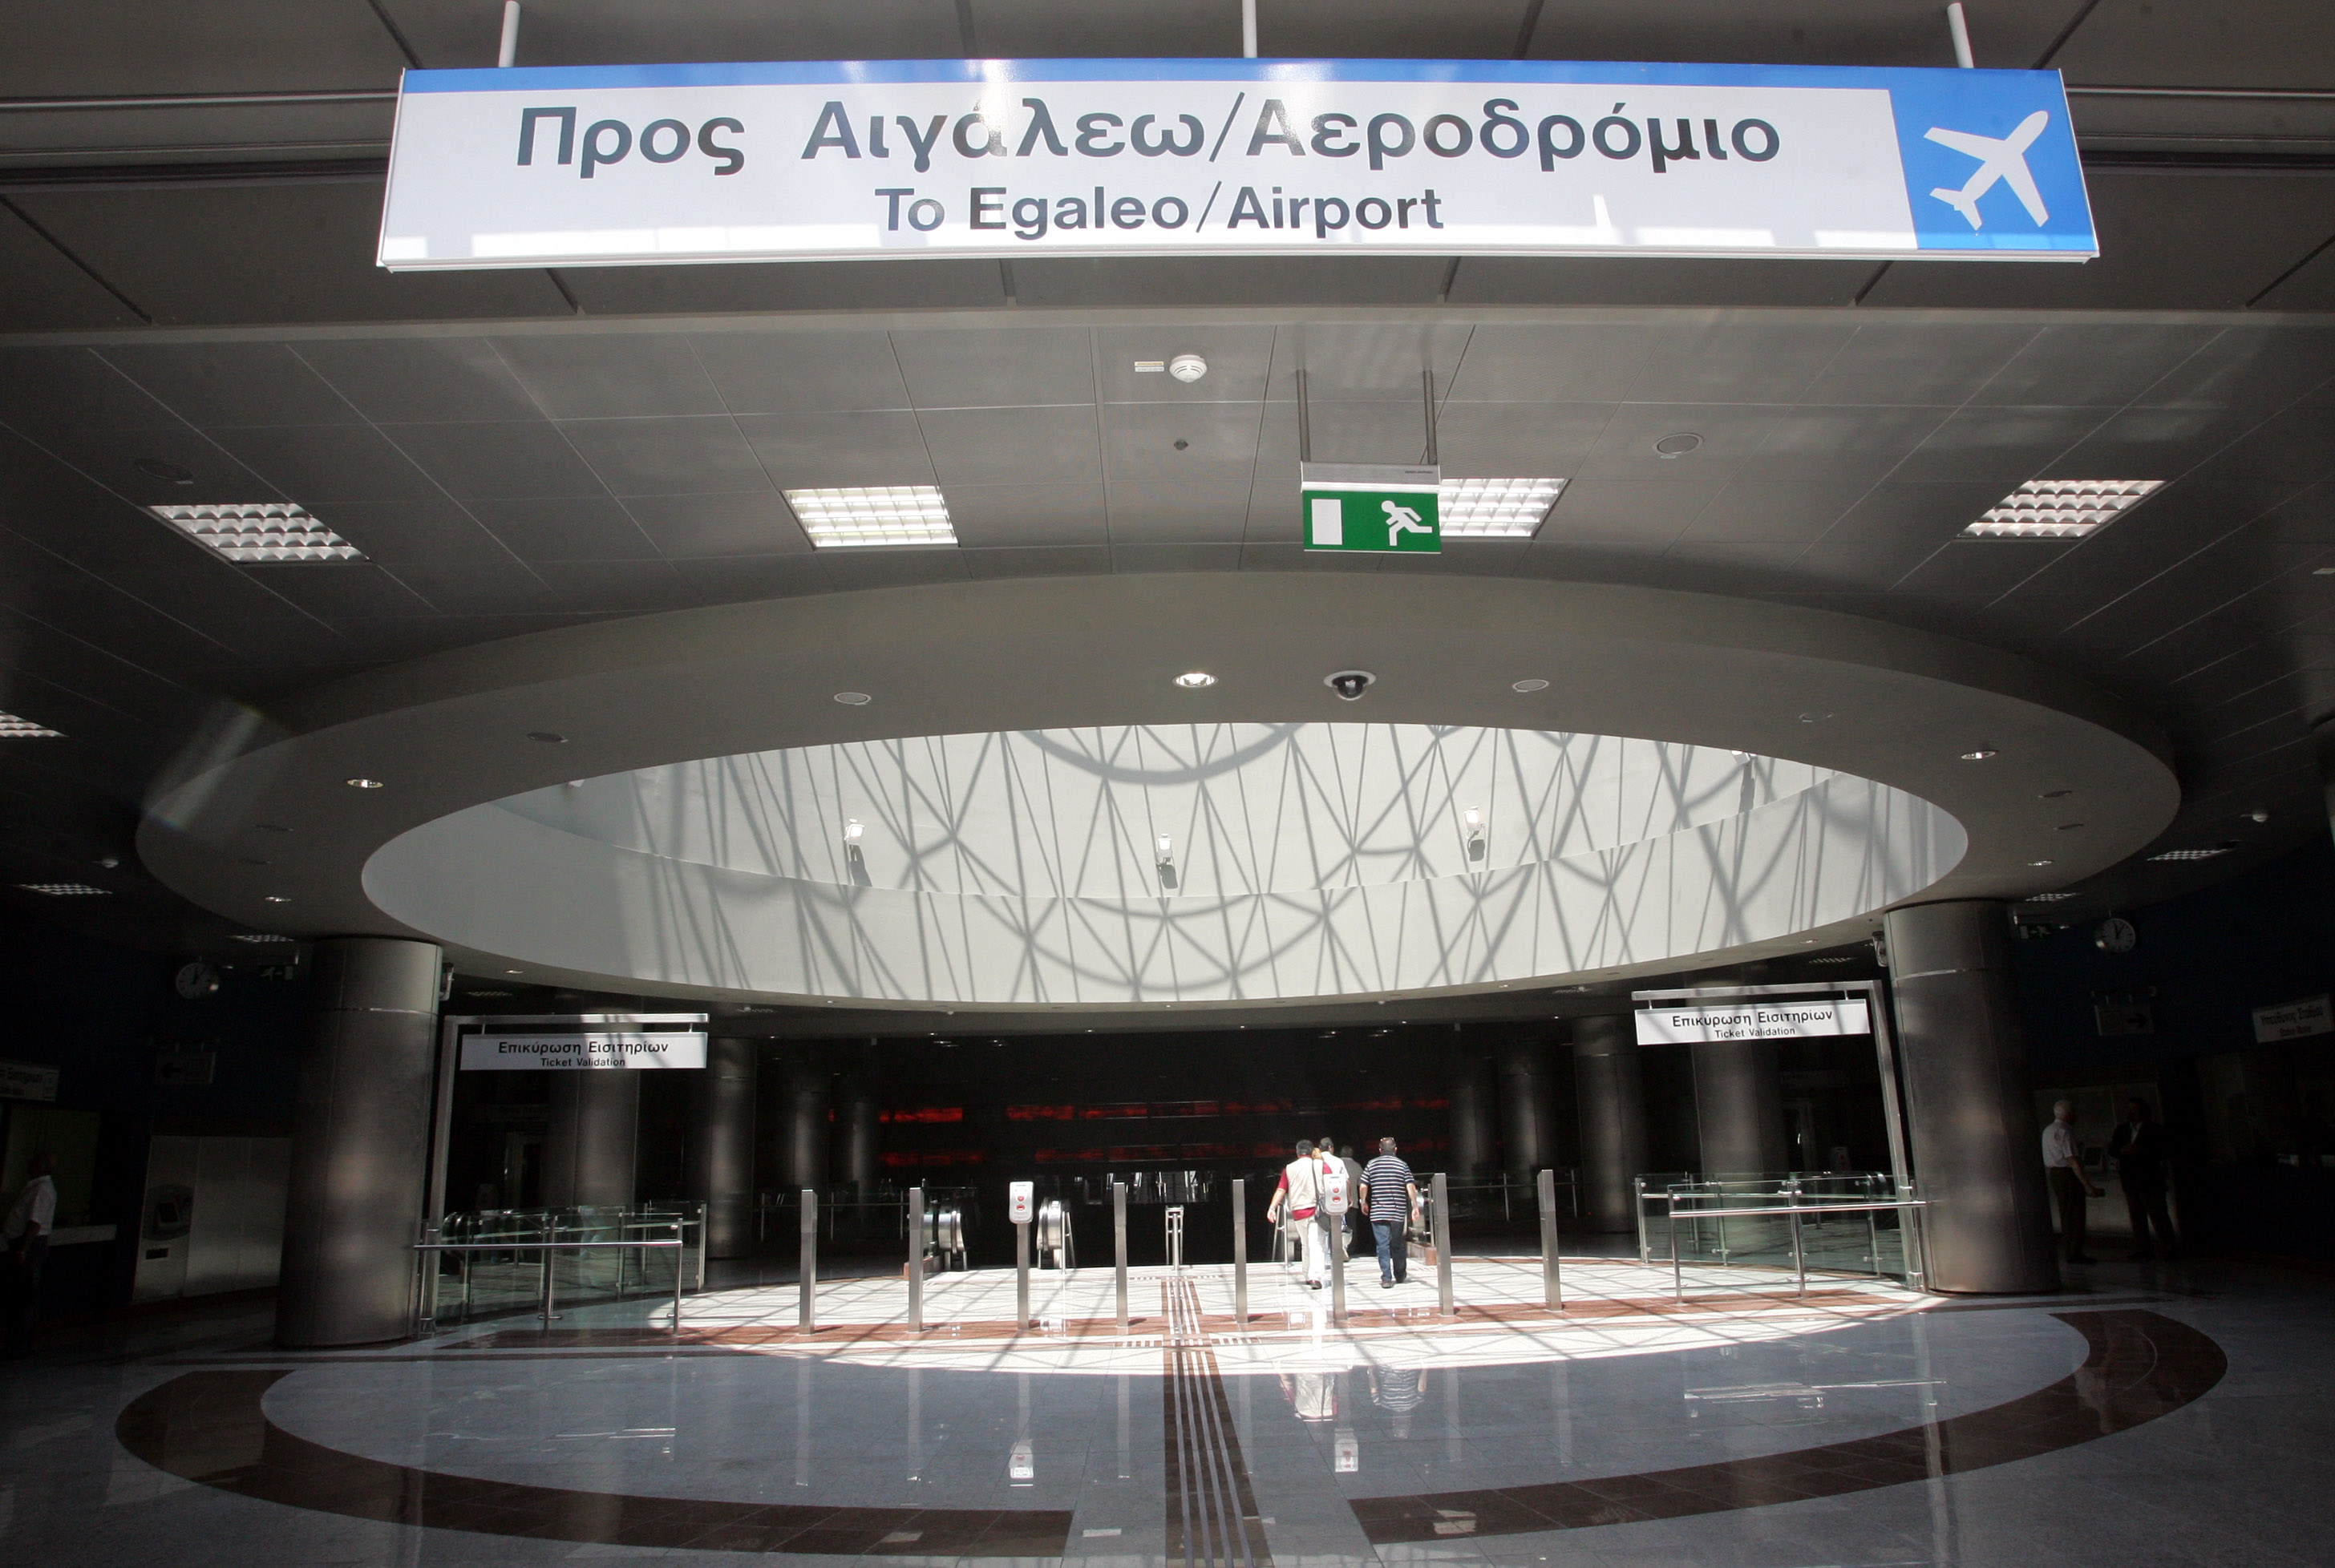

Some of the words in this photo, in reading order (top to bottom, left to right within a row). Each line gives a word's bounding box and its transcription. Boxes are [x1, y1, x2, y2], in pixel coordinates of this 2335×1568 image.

[517, 106, 745, 179] Προς
[801, 91, 1780, 173] Αιγάλεω/Αεροδρόμιο
[875, 188, 945, 232] To
[970, 180, 1444, 240] Egaleo/Airport
[1672, 1014, 1752, 1028] Επικύρωση
[1758, 1009, 1833, 1024] Εισιτηρίων
[1714, 1028, 1745, 1039] Ticket
[1749, 1026, 1795, 1037] Validation
[498, 1041, 581, 1056] Επικύρωση
[588, 1040, 669, 1056] Εισιτηρίων
[540, 1057, 573, 1067] Ticket
[576, 1057, 626, 1067] Validation
